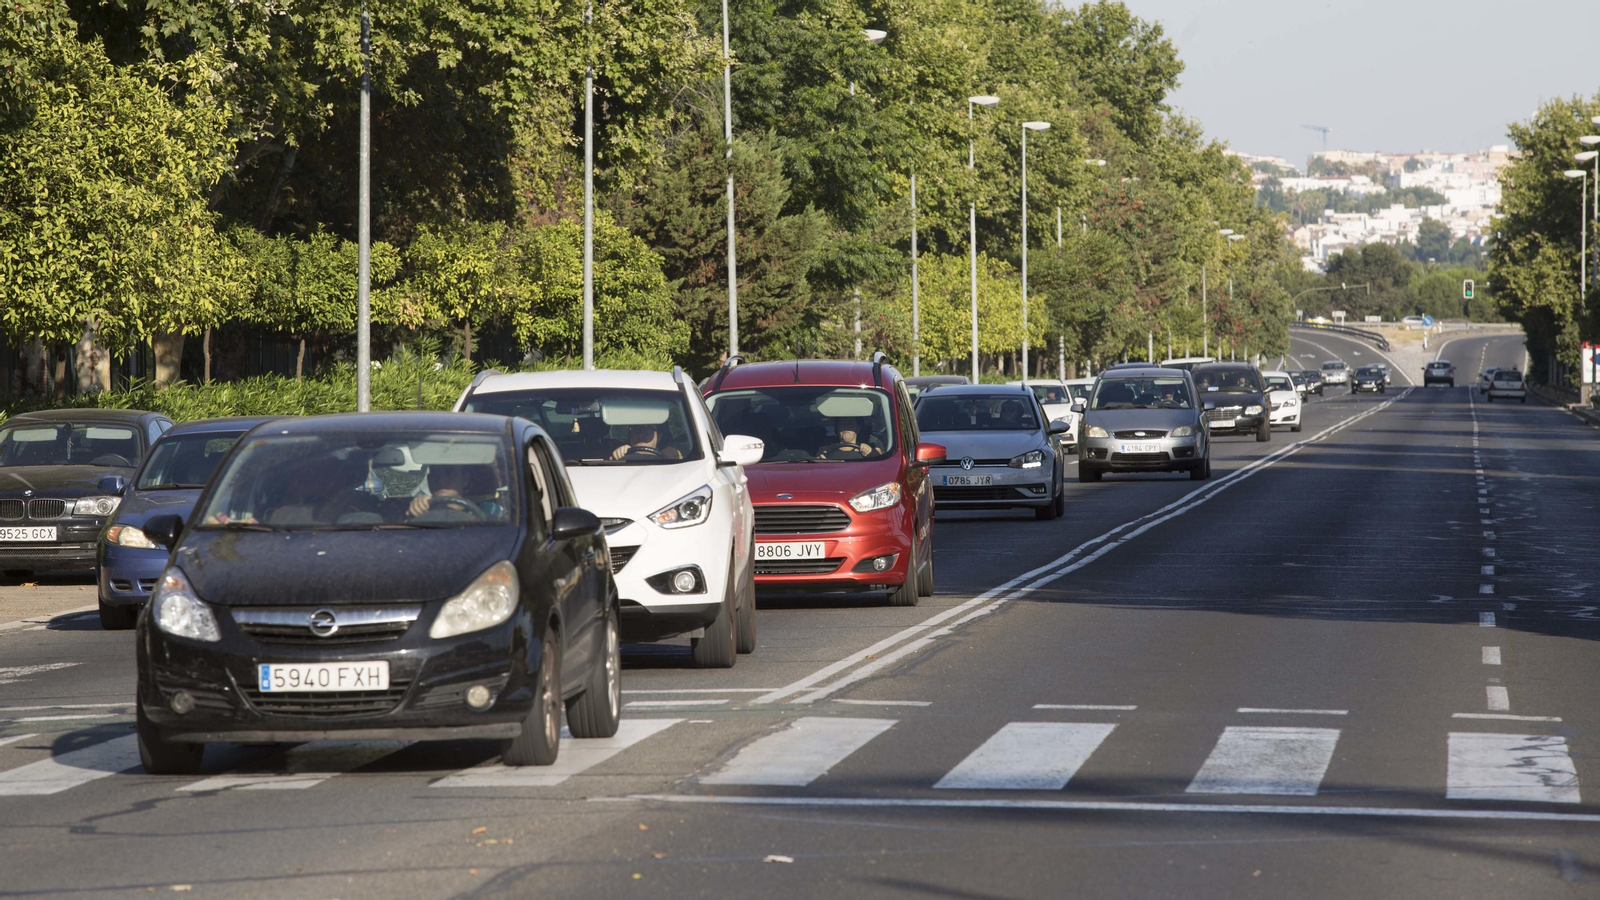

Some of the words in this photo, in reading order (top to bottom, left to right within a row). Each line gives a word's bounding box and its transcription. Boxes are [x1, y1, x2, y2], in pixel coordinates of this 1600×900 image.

[948, 476, 971, 485] 0785
[974, 476, 991, 485] JYR
[0, 528, 28, 540] 9525
[31, 528, 54, 540] GCX
[757, 544, 792, 558] 8806
[796, 544, 822, 557] JVY
[274, 668, 330, 688] 5940
[337, 667, 380, 687] FXH
